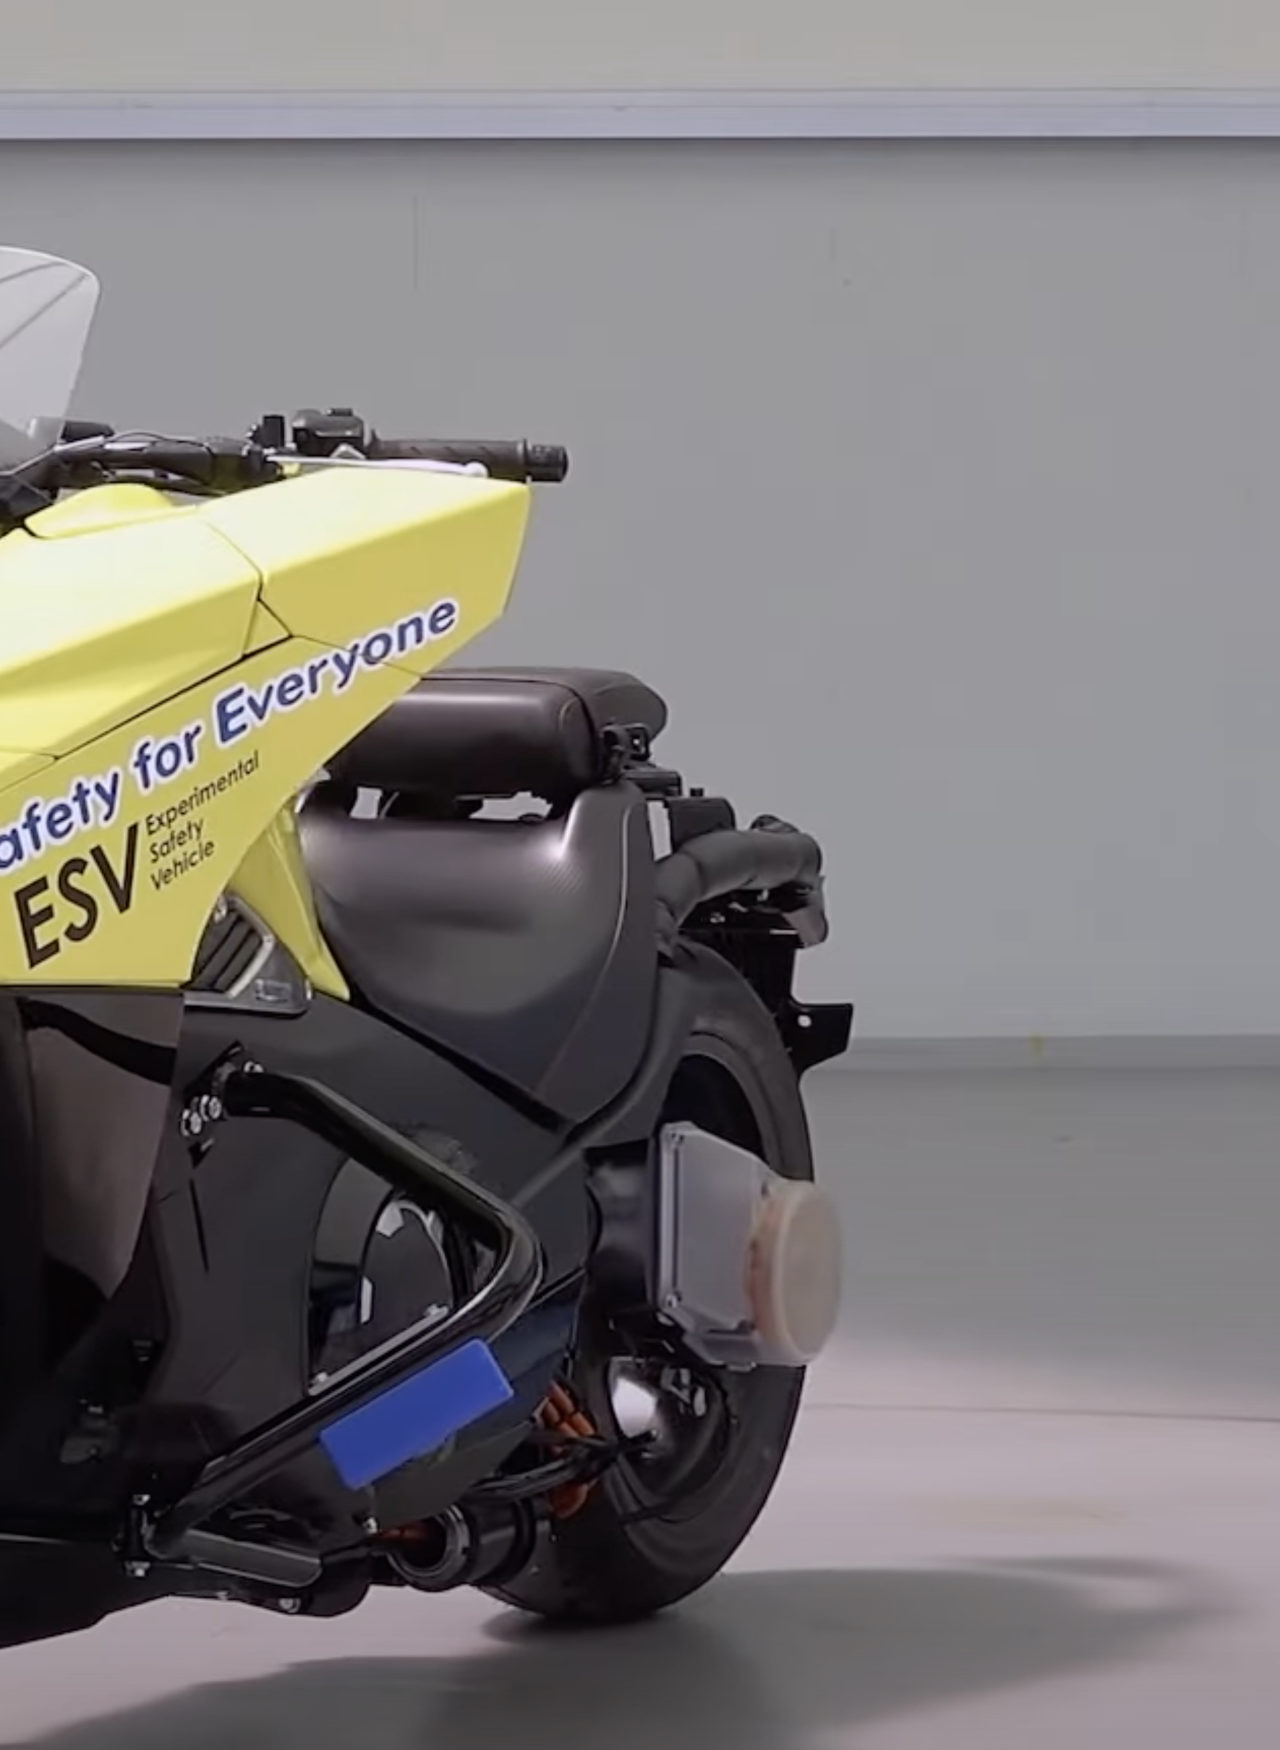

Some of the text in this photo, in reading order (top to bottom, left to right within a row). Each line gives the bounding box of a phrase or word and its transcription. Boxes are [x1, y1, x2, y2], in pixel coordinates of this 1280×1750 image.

[133, 724, 201, 790] for
[215, 601, 457, 744] Everyone
[146, 751, 260, 836] Experimental
[150, 819, 205, 865] Safety
[151, 840, 214, 892] Vehicle
[14, 822, 140, 969] ESV
